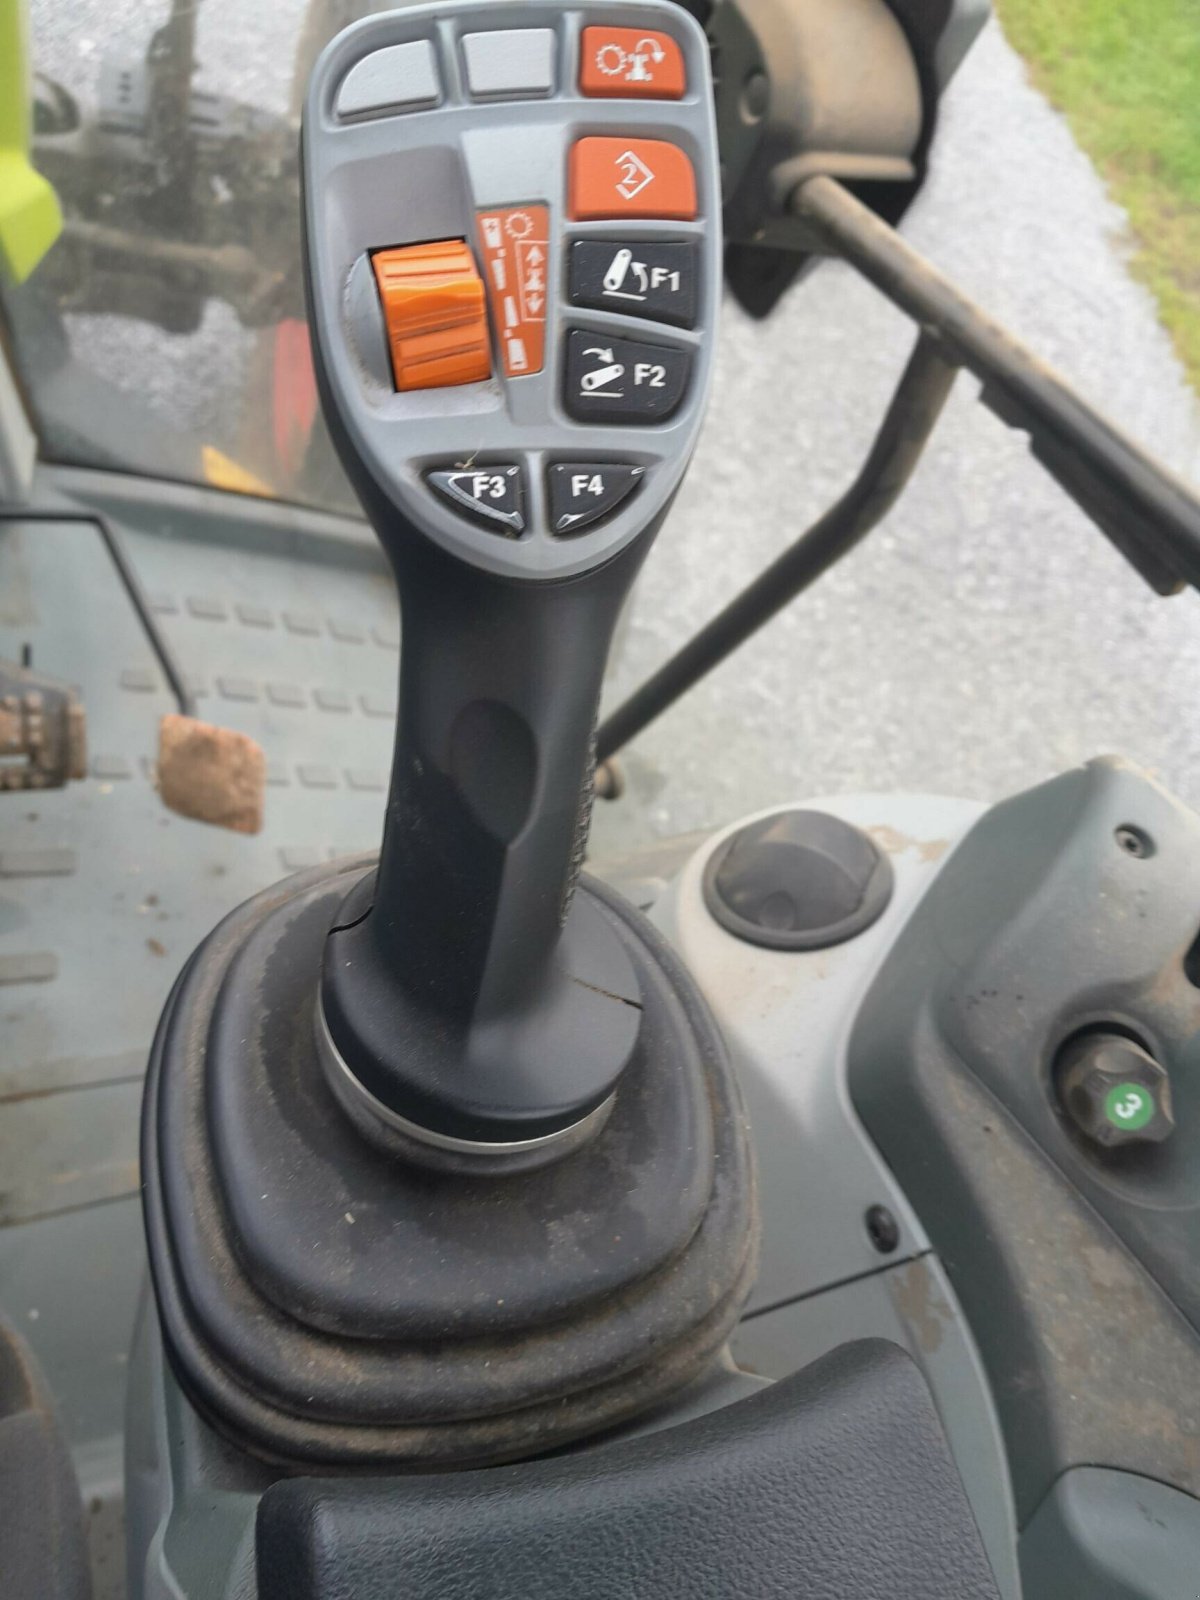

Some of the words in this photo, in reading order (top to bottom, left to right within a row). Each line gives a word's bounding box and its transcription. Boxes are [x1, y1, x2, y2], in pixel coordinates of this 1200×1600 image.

[621, 163, 638, 184] 2
[651, 267, 680, 292] F1
[634, 363, 666, 387] F2
[472, 475, 506, 498] F3
[571, 474, 604, 497] F4
[1115, 1093, 1142, 1119] 3
